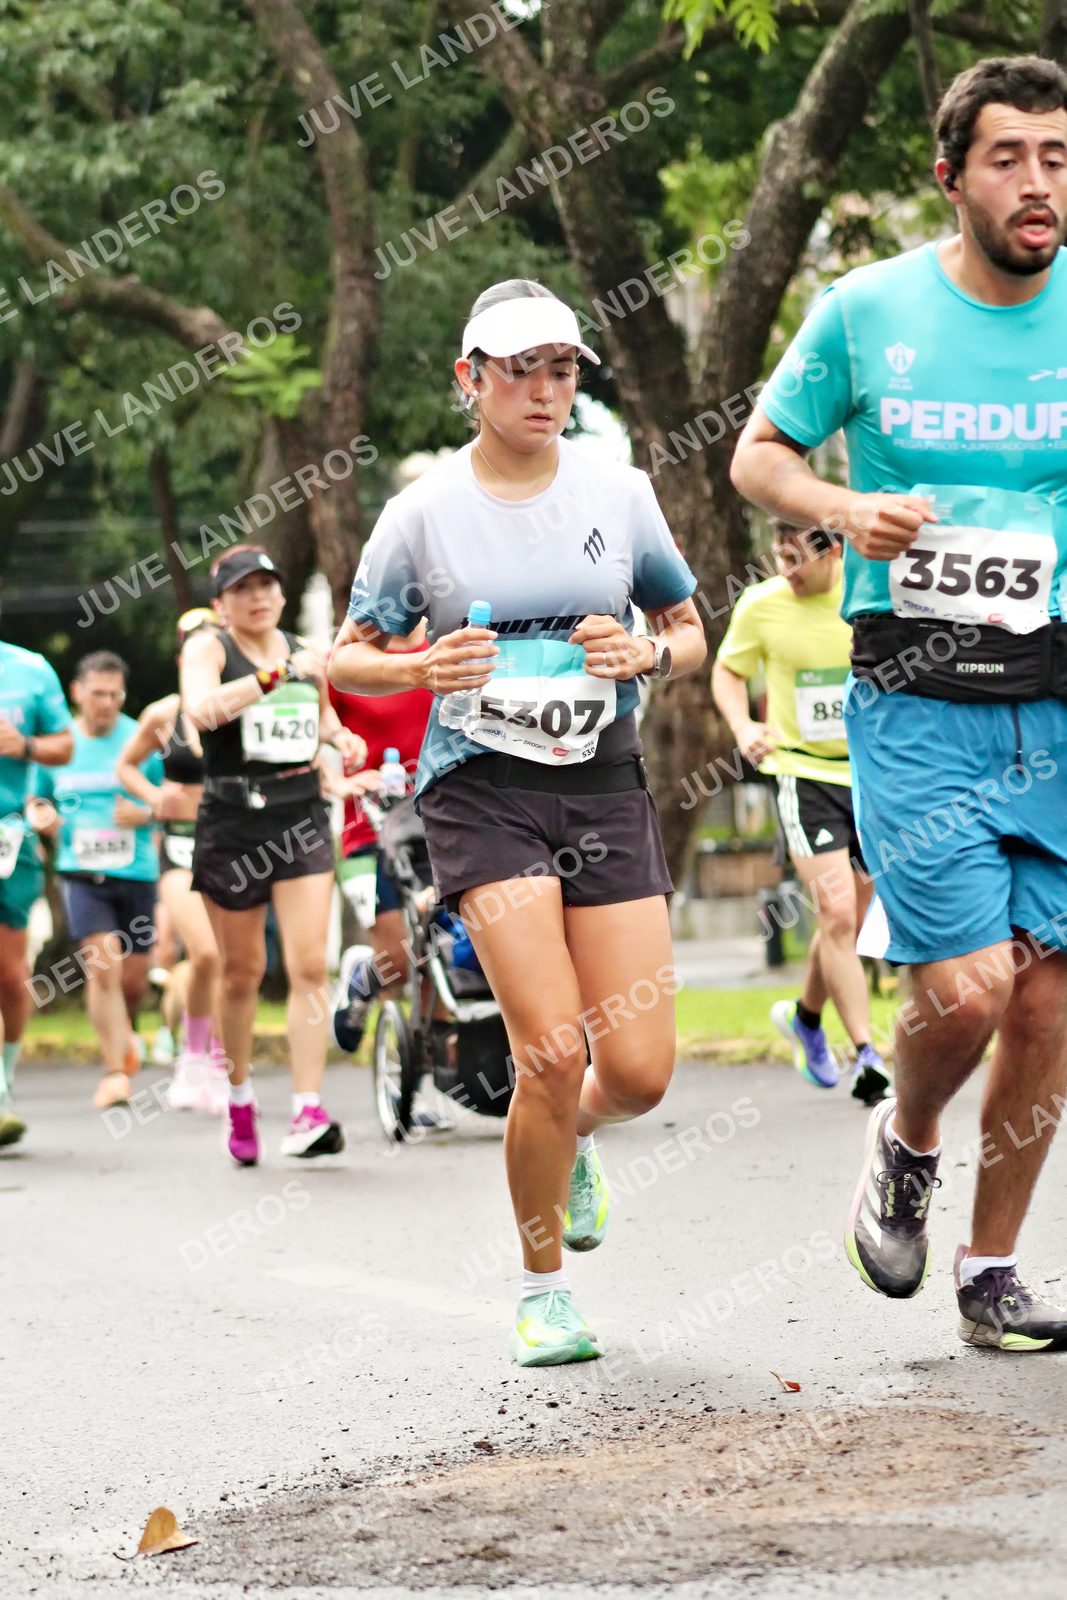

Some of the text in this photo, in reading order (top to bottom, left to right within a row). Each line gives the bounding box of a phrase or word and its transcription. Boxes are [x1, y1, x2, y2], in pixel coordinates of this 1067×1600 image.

[900, 548, 1042, 601] 3563
[956, 663, 1004, 674] KIPRUN
[253, 719, 317, 743] 1420
[480, 695, 606, 739] 5307
